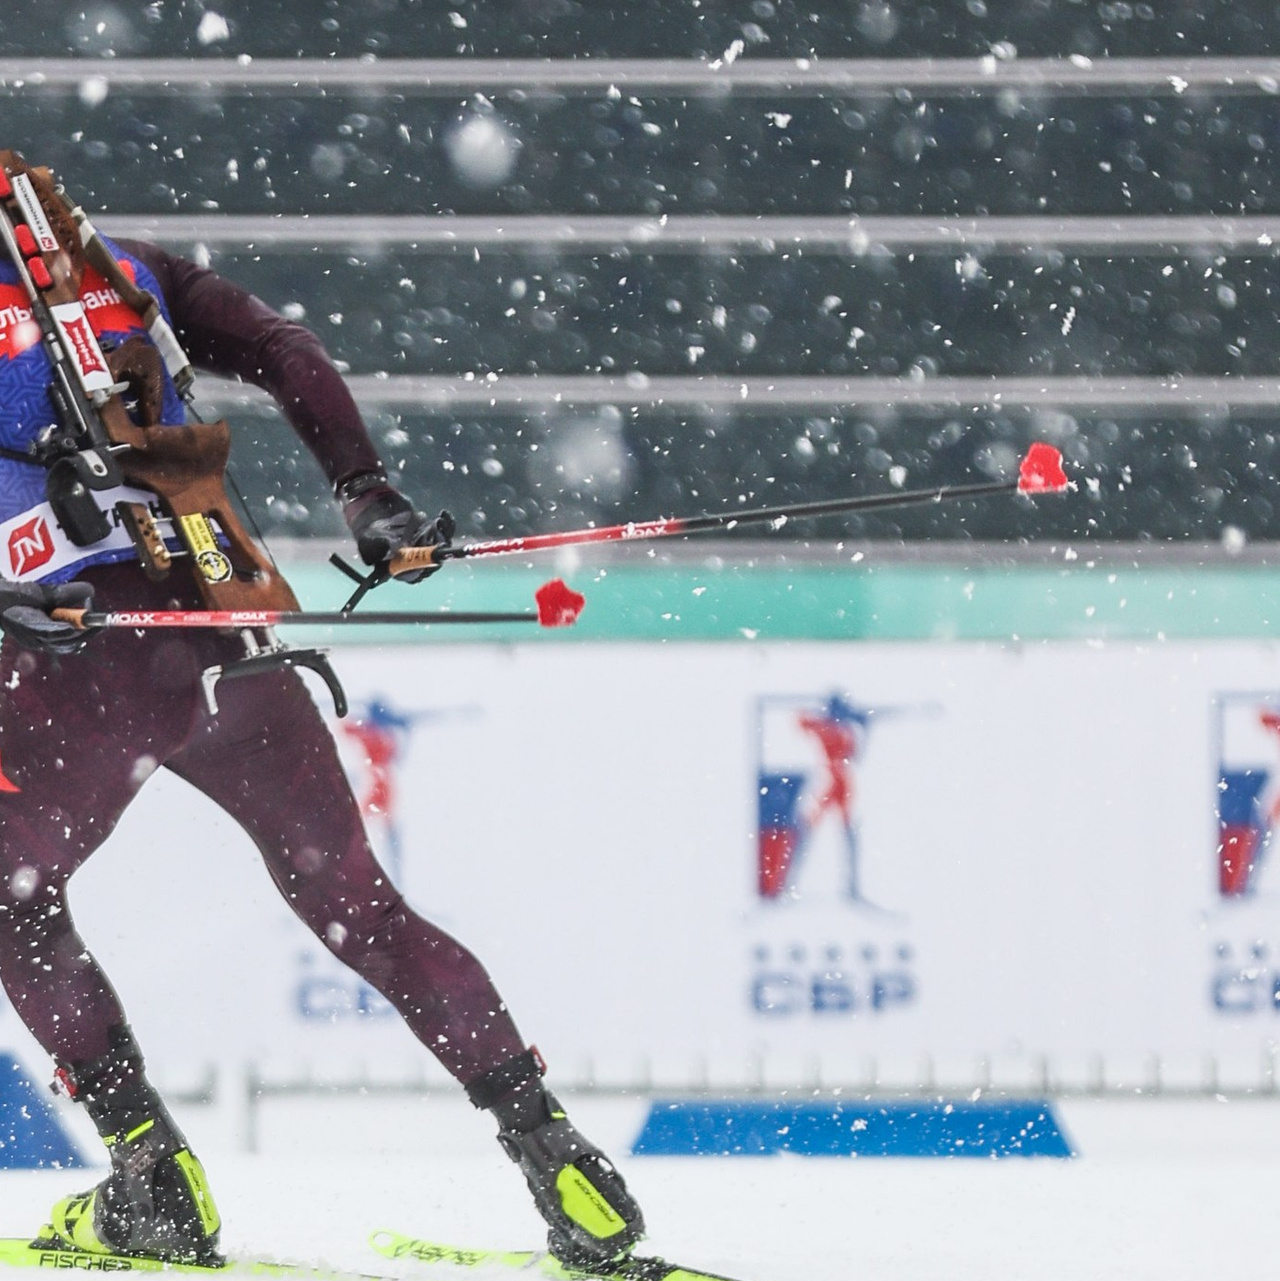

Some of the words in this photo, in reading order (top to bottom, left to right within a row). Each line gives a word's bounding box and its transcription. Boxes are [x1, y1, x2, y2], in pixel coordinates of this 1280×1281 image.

[106, 613, 155, 625] MOAX
[231, 612, 268, 621] MOAX
[295, 977, 397, 1021] СБ
[40, 1254, 132, 1272] FISCHER
